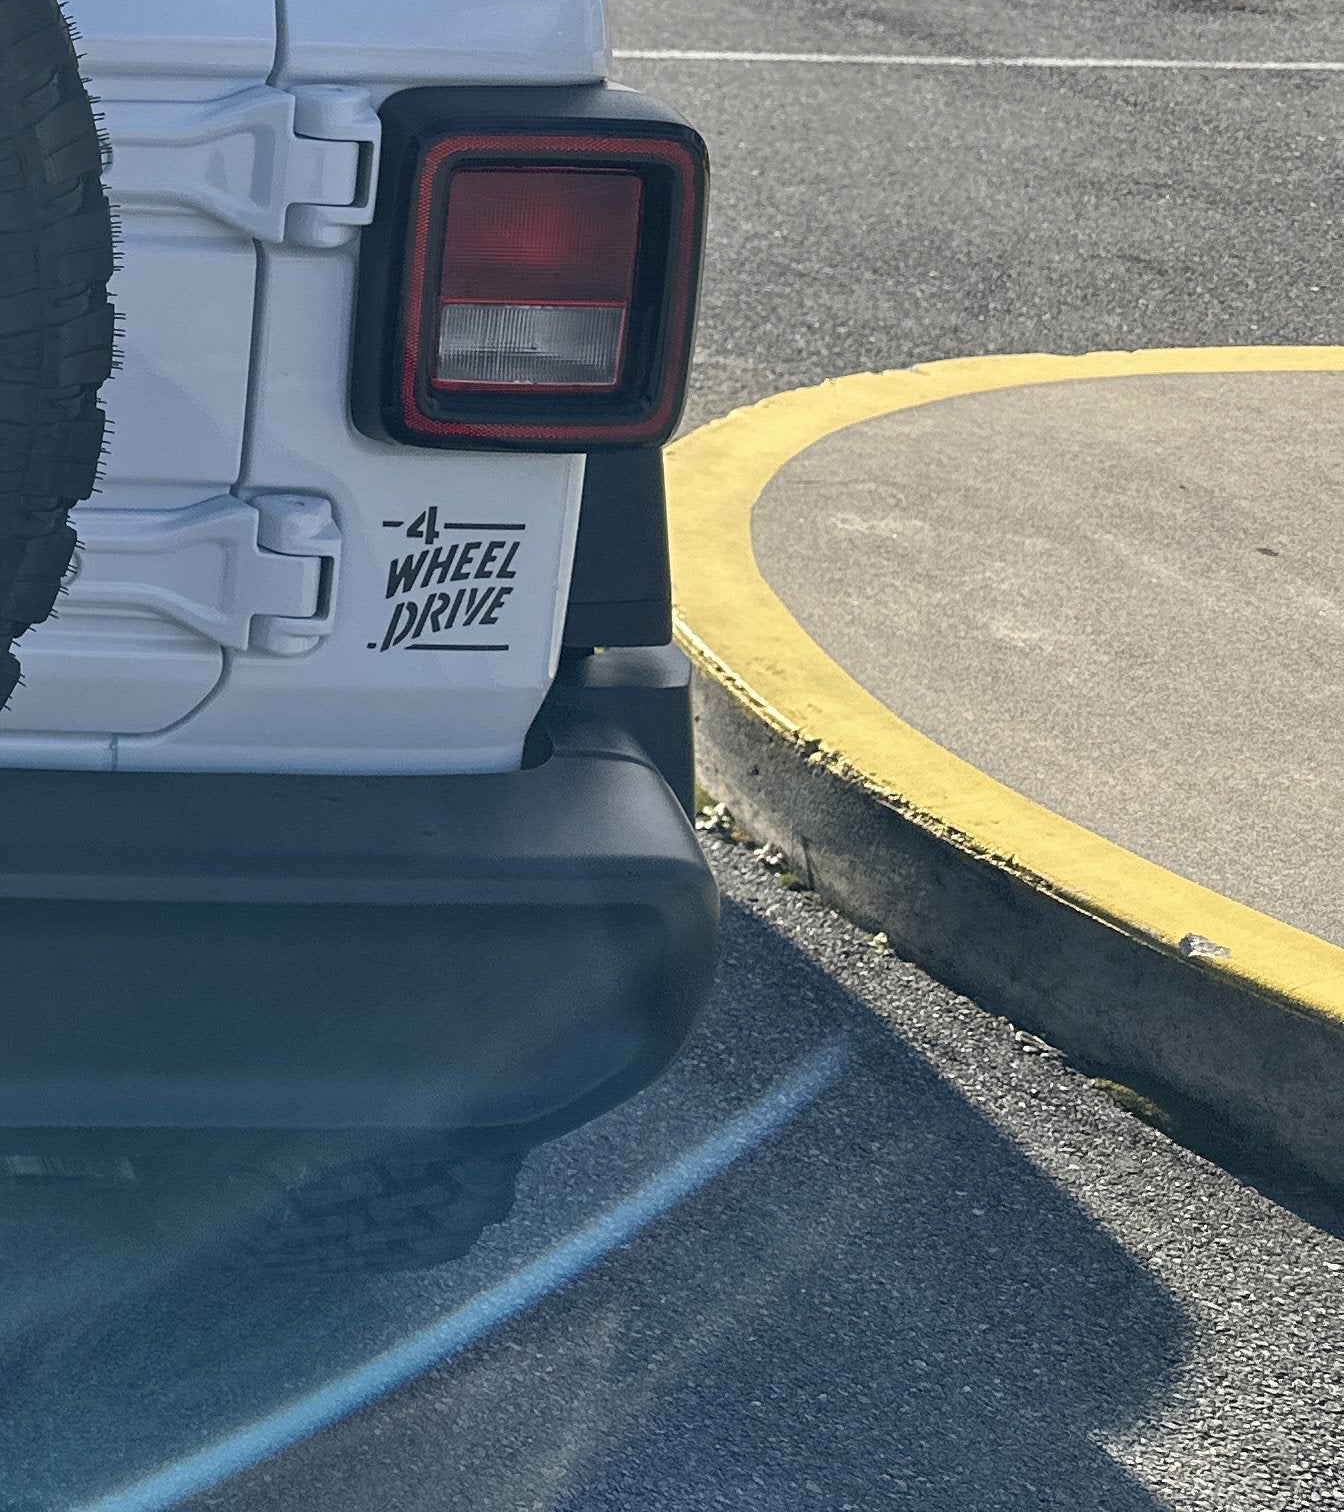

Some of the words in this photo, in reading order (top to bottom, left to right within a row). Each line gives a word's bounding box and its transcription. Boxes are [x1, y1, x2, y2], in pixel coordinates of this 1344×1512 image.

[406, 506, 440, 545] 4
[385, 541, 520, 599] WHEEL
[380, 587, 514, 653] DRIVE
